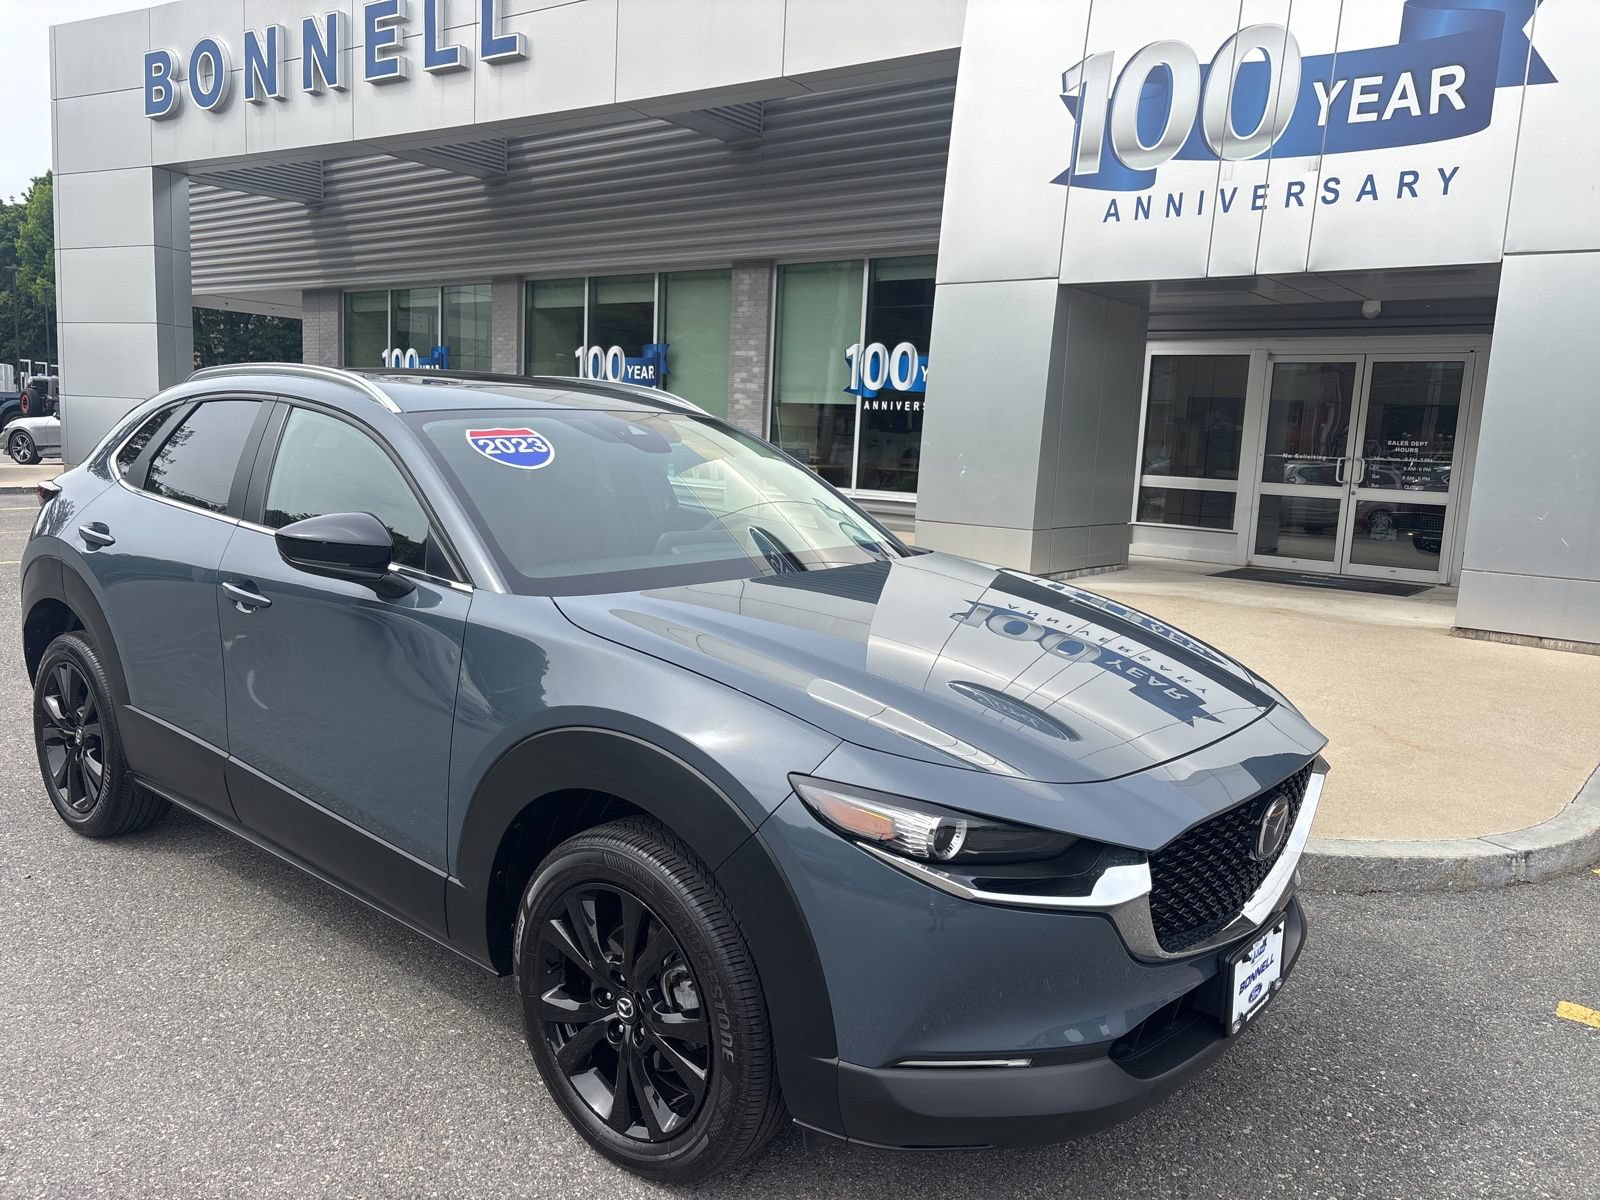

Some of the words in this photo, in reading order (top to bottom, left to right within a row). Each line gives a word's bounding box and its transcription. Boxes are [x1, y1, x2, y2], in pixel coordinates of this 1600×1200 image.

[144, 0, 526, 120] BONNELL
[1062, 23, 1301, 175] 100
[1312, 64, 1467, 127] YEAR
[1103, 166, 1460, 224] ANNIVERSARY
[382, 348, 419, 368] 100
[575, 345, 625, 382] 100
[627, 365, 655, 379] YEAR
[845, 342, 919, 391] 100
[477, 436, 549, 456] 2023
[1239, 953, 1274, 996] BONNELL
